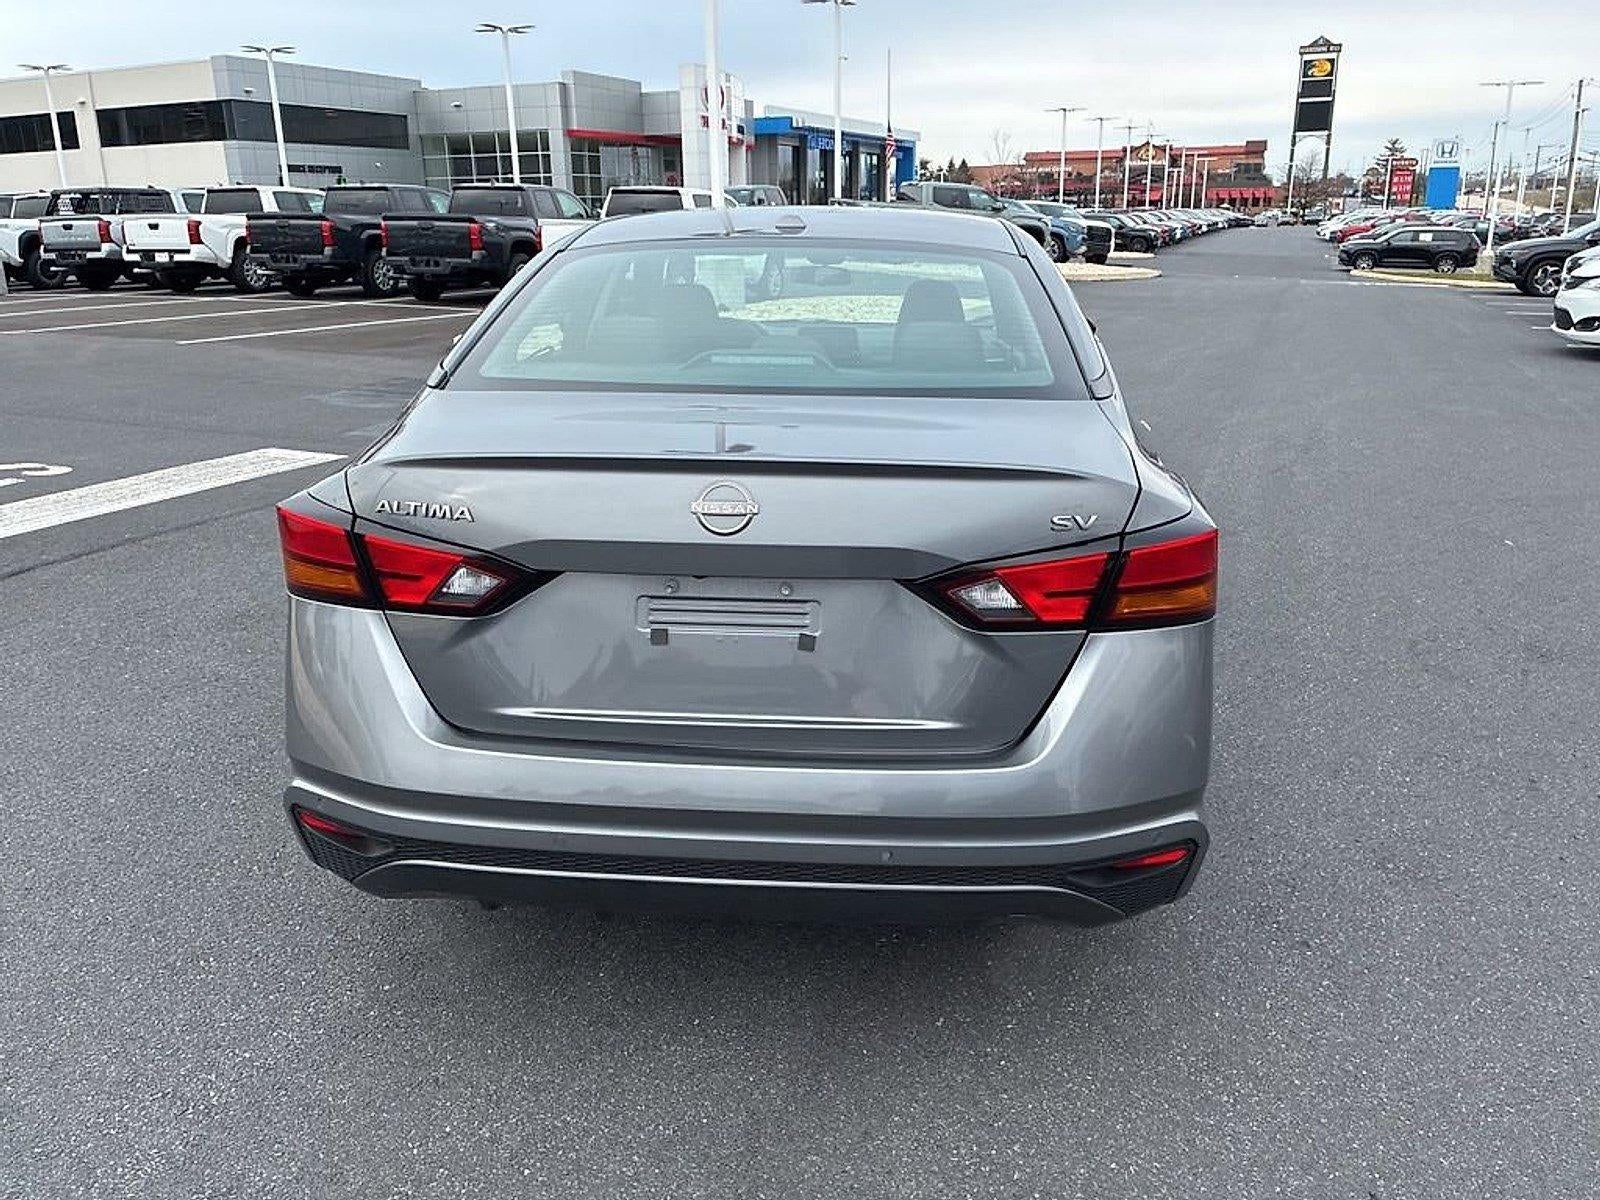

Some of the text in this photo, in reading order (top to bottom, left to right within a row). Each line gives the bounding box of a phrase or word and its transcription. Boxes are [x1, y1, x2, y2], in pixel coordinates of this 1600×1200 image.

[375, 499, 475, 522] ALTIMA
[690, 501, 759, 515] NISSAN
[1050, 515, 1098, 531] SV
